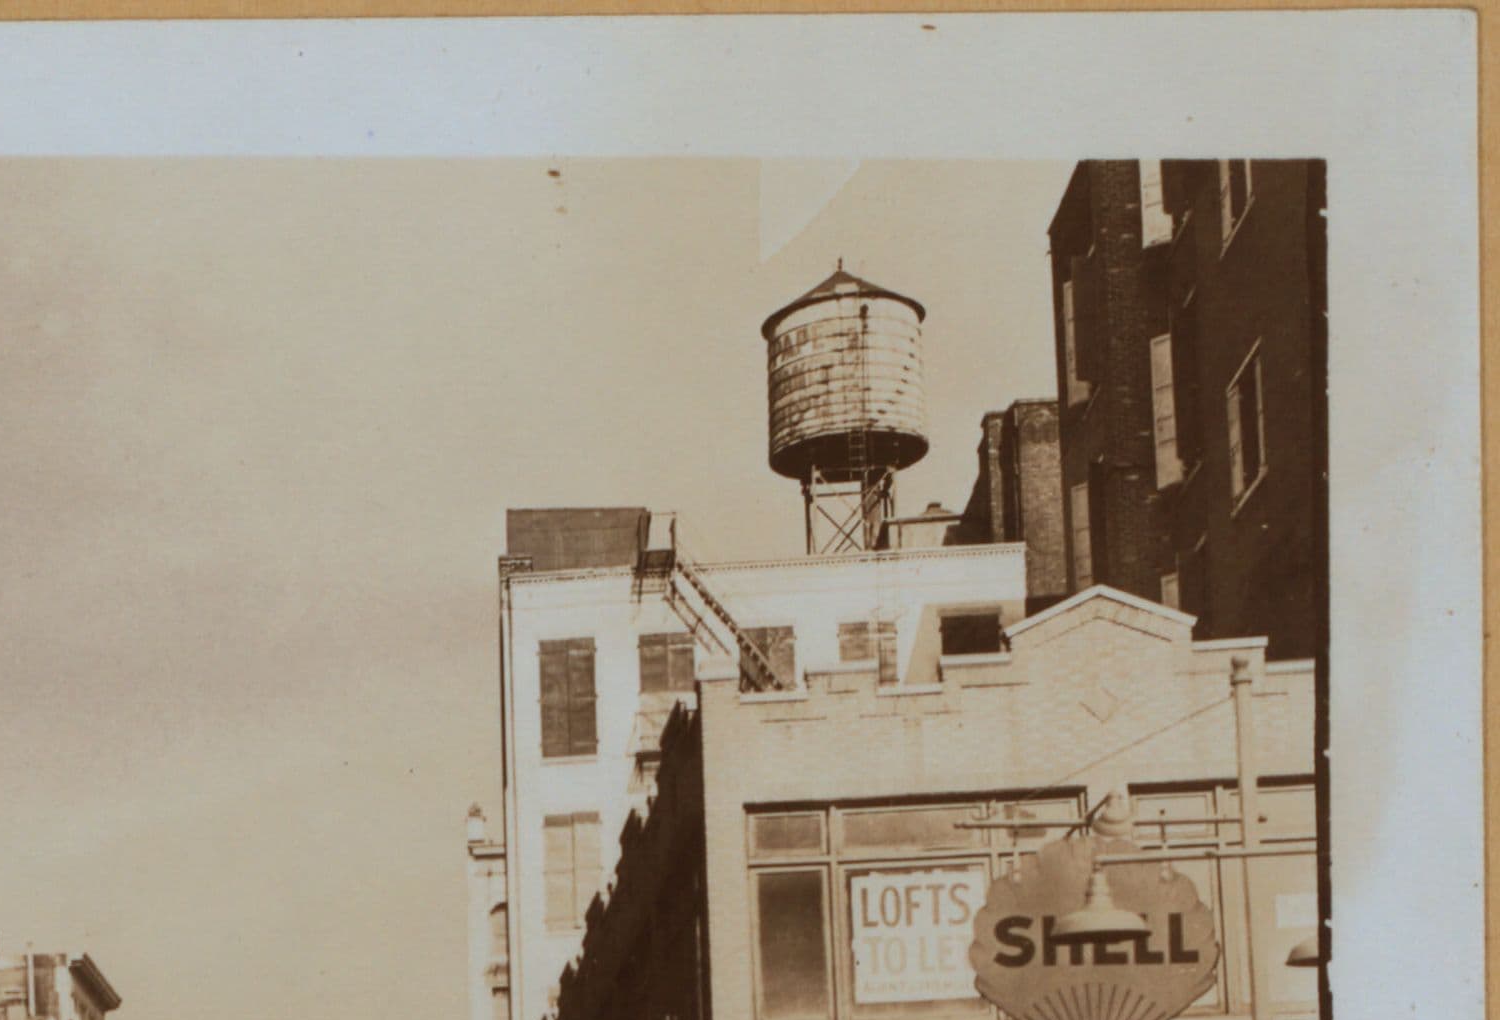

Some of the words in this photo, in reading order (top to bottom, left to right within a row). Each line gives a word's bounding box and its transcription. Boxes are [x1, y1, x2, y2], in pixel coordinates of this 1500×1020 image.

[860, 883, 971, 928] LOFTS
[862, 935, 907, 976] TO
[919, 934, 968, 973] LE
